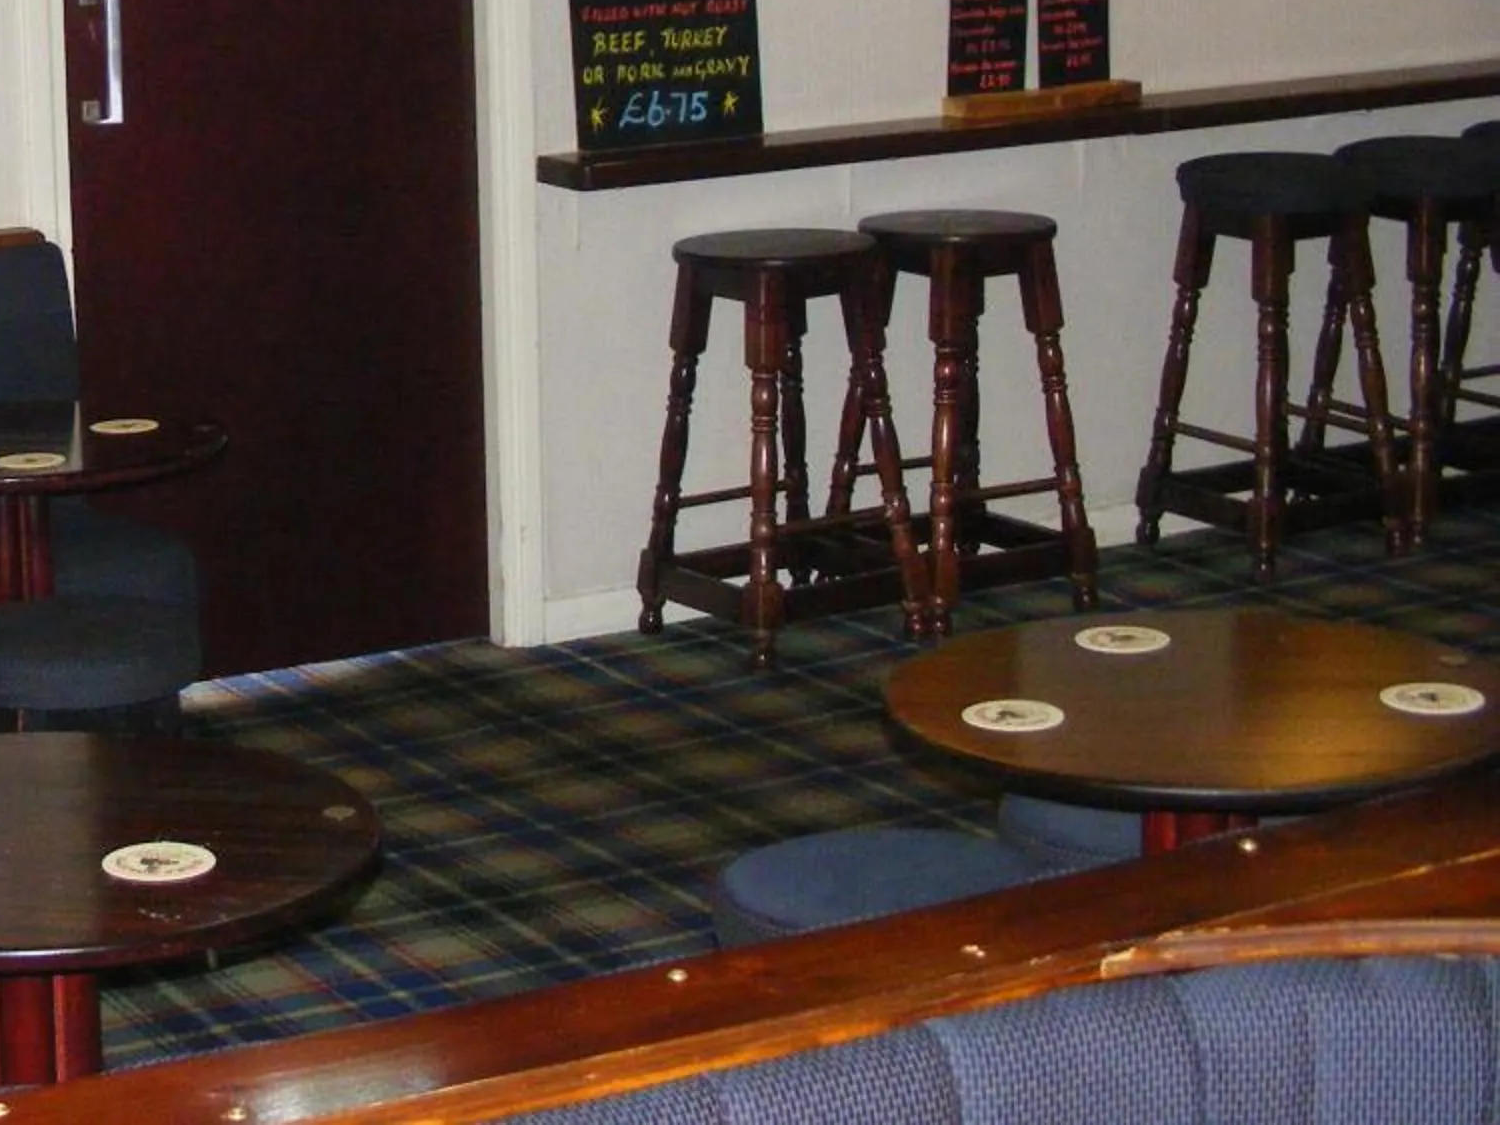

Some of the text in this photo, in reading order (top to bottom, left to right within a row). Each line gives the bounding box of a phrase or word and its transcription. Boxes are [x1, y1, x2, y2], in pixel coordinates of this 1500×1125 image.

[659, 26, 728, 50] TURKEY
[582, 64, 605, 85] OR
[617, 62, 665, 84] PORK
[694, 55, 750, 82] GRAVY
